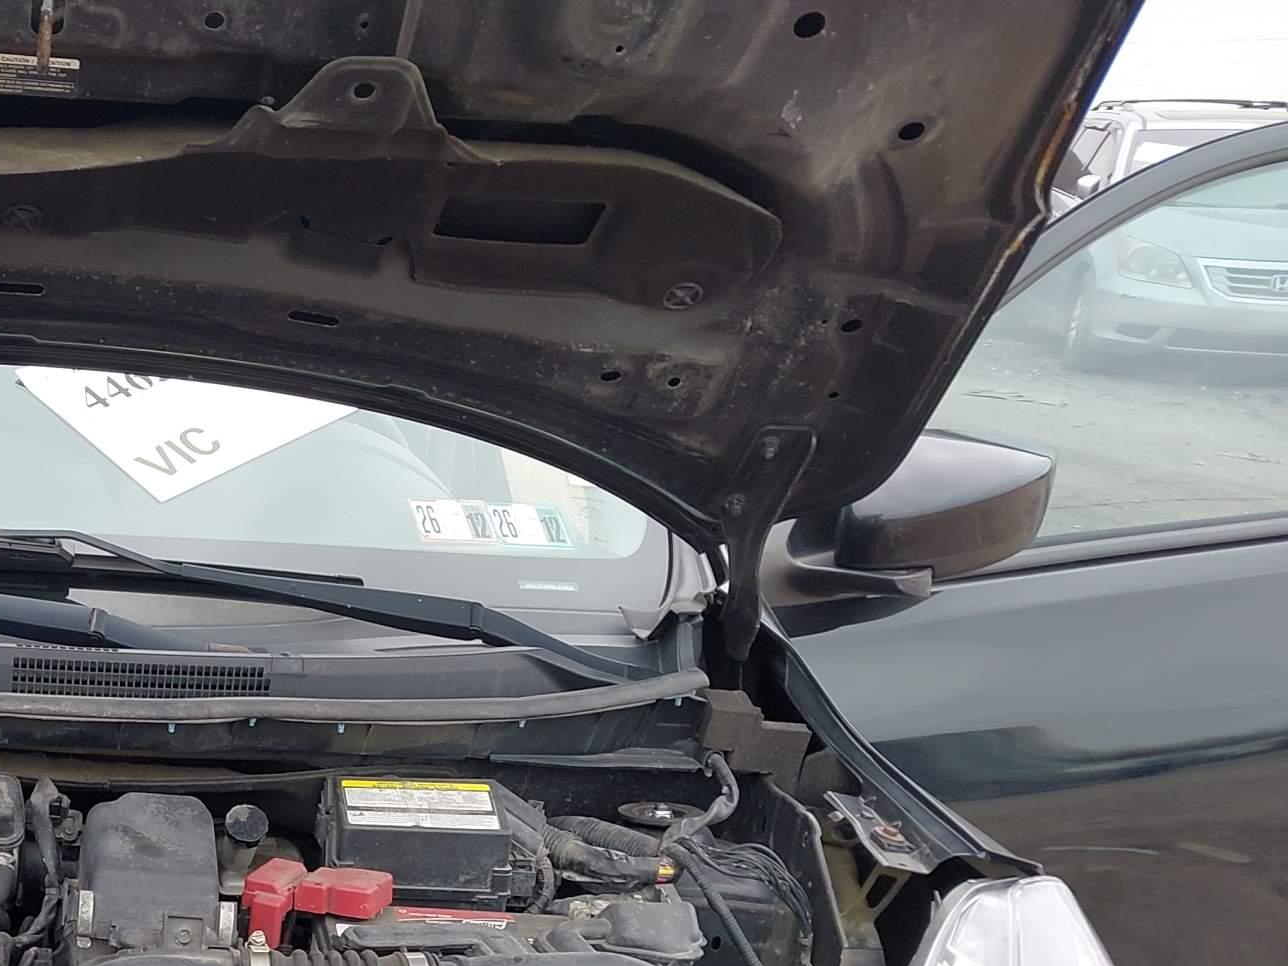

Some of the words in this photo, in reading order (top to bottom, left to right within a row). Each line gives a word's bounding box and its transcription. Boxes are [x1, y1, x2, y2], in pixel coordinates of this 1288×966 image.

[1, 56, 30, 64] CAUTION
[133, 428, 221, 475] VIC
[416, 505, 441, 534] 26
[492, 509, 518, 538] 26
